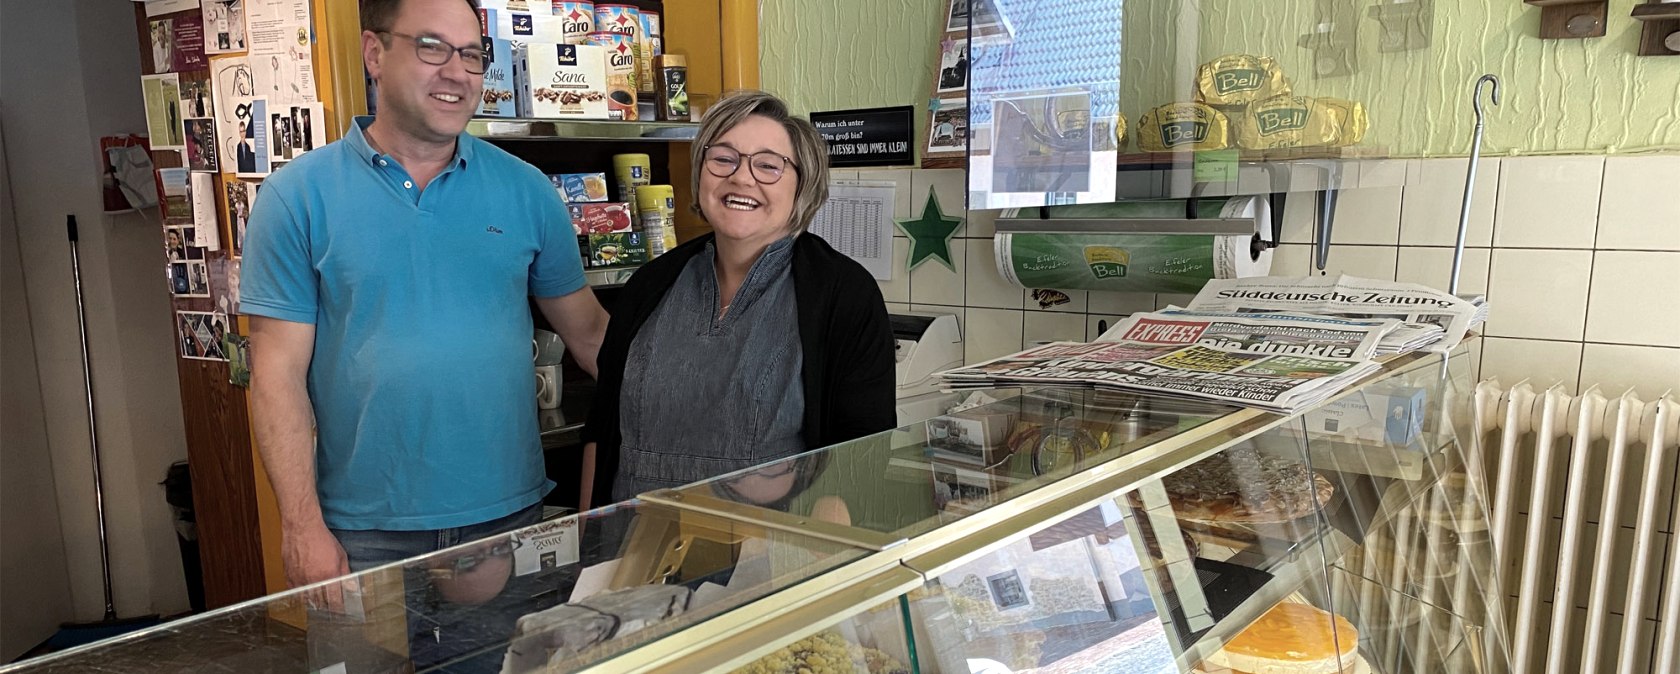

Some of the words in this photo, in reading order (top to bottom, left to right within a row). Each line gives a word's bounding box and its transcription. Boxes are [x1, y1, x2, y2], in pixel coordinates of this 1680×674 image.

[562, 21, 588, 33] Caro
[610, 54, 633, 67] Caro
[552, 70, 586, 83] Sana
[1217, 72, 1258, 90] Bell
[1260, 111, 1302, 130] Bell
[835, 133, 850, 141] groß
[850, 131, 863, 139] bin?
[1164, 124, 1204, 142] Bell
[826, 143, 855, 155] KATESSEN
[856, 142, 868, 154] SIND
[869, 142, 888, 154] IMMER
[1093, 265, 1124, 277] Bell
[1216, 289, 1360, 303] Süddeutsche
[1362, 292, 1455, 308] Zeitung
[1126, 323, 1203, 343] EXPRESS
[1213, 322, 1287, 331] Mordverdacht
[1247, 340, 1352, 358] dunkle
[1165, 383, 1200, 392] immer
[1200, 386, 1239, 397] wieder
[1238, 389, 1277, 402] Kinder
[1242, 385, 1278, 394] schon
